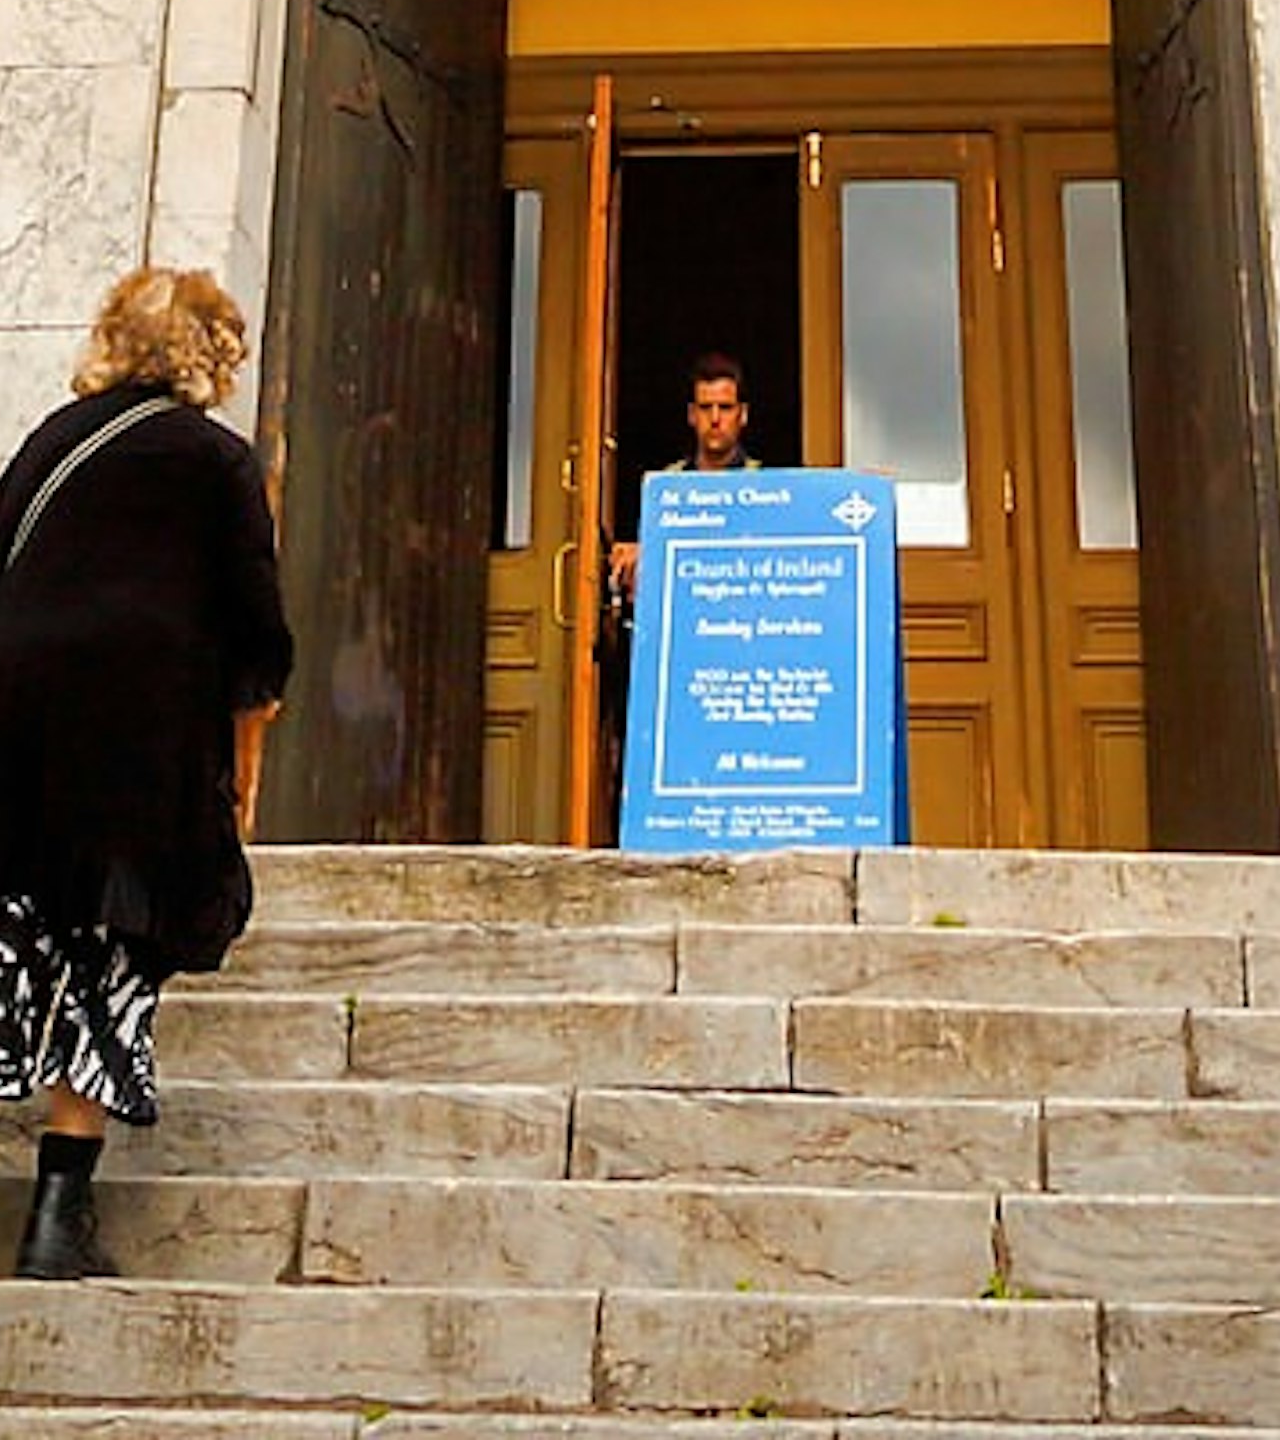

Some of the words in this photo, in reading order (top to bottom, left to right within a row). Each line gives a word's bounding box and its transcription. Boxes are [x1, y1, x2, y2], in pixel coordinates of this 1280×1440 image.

[737, 485, 792, 506] Church
[676, 558, 748, 578] Church
[751, 558, 773, 578] of
[775, 555, 844, 578] Ireland
